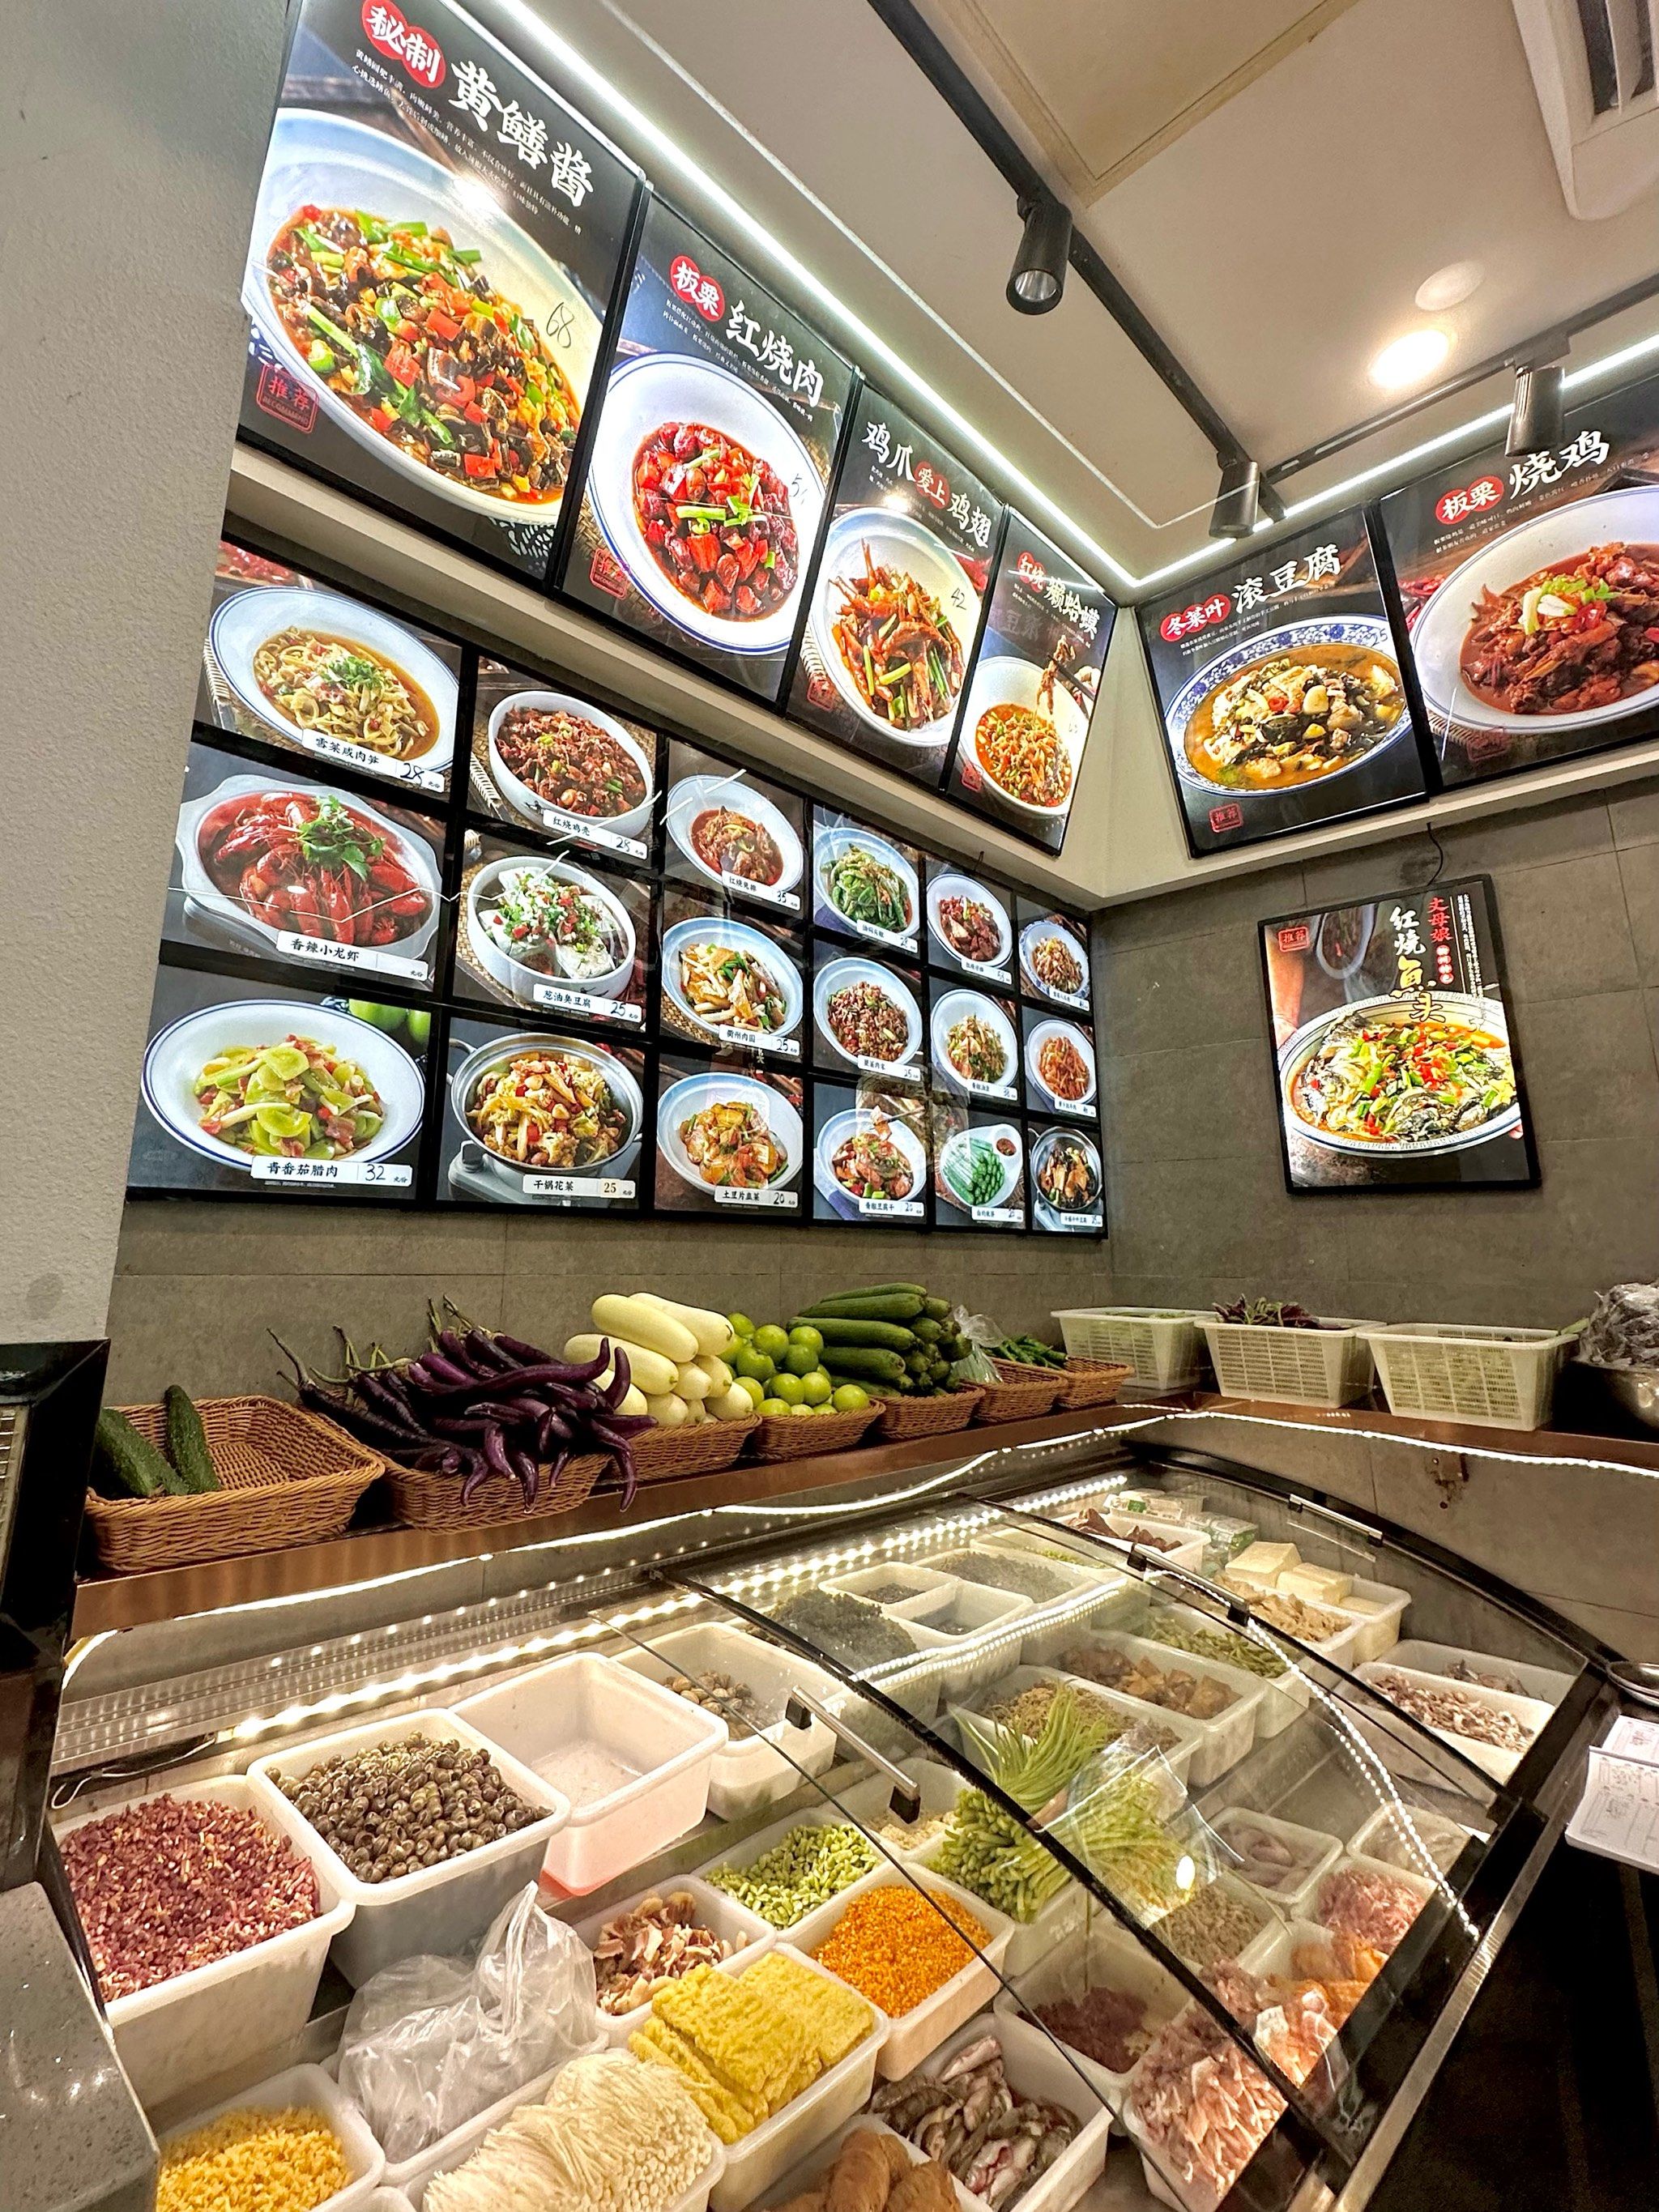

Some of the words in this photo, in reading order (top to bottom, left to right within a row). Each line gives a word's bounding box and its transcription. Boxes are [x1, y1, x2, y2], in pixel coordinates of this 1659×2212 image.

[366, 6, 441, 83] 秘制
[449, 61, 595, 207] 黄鳝酱
[547, 301, 573, 349] 68
[673, 261, 719, 317] 板栗
[725, 300, 824, 407] 红烧肉
[268, 376, 309, 411] 推荐
[862, 421, 916, 482] 鸡爪
[916, 467, 945, 505] 爱上
[947, 492, 992, 548] 鸡翅
[1442, 480, 1500, 520] 板栗
[1509, 431, 1610, 499] 烧鸡
[951, 588, 966, 610] 42
[1166, 599, 1225, 636] 冬菜叶
[1231, 543, 1341, 614] 滚豆腐
[400, 762, 424, 786] 28
[616, 837, 631, 852] 28
[1427, 897, 1453, 943] 丈母娘
[290, 938, 360, 961] 香辣小龙虾
[543, 990, 591, 1008] 葱油臭豆腐
[611, 1002, 625, 1016] 25
[776, 1038, 788, 1051] 25
[267, 1161, 338, 1178] 青番茄腊肉
[365, 1163, 386, 1181] 32
[533, 1179, 574, 1191] 干锅花菜
[603, 1183, 616, 1193] 25
[773, 1191, 785, 1204] 20
